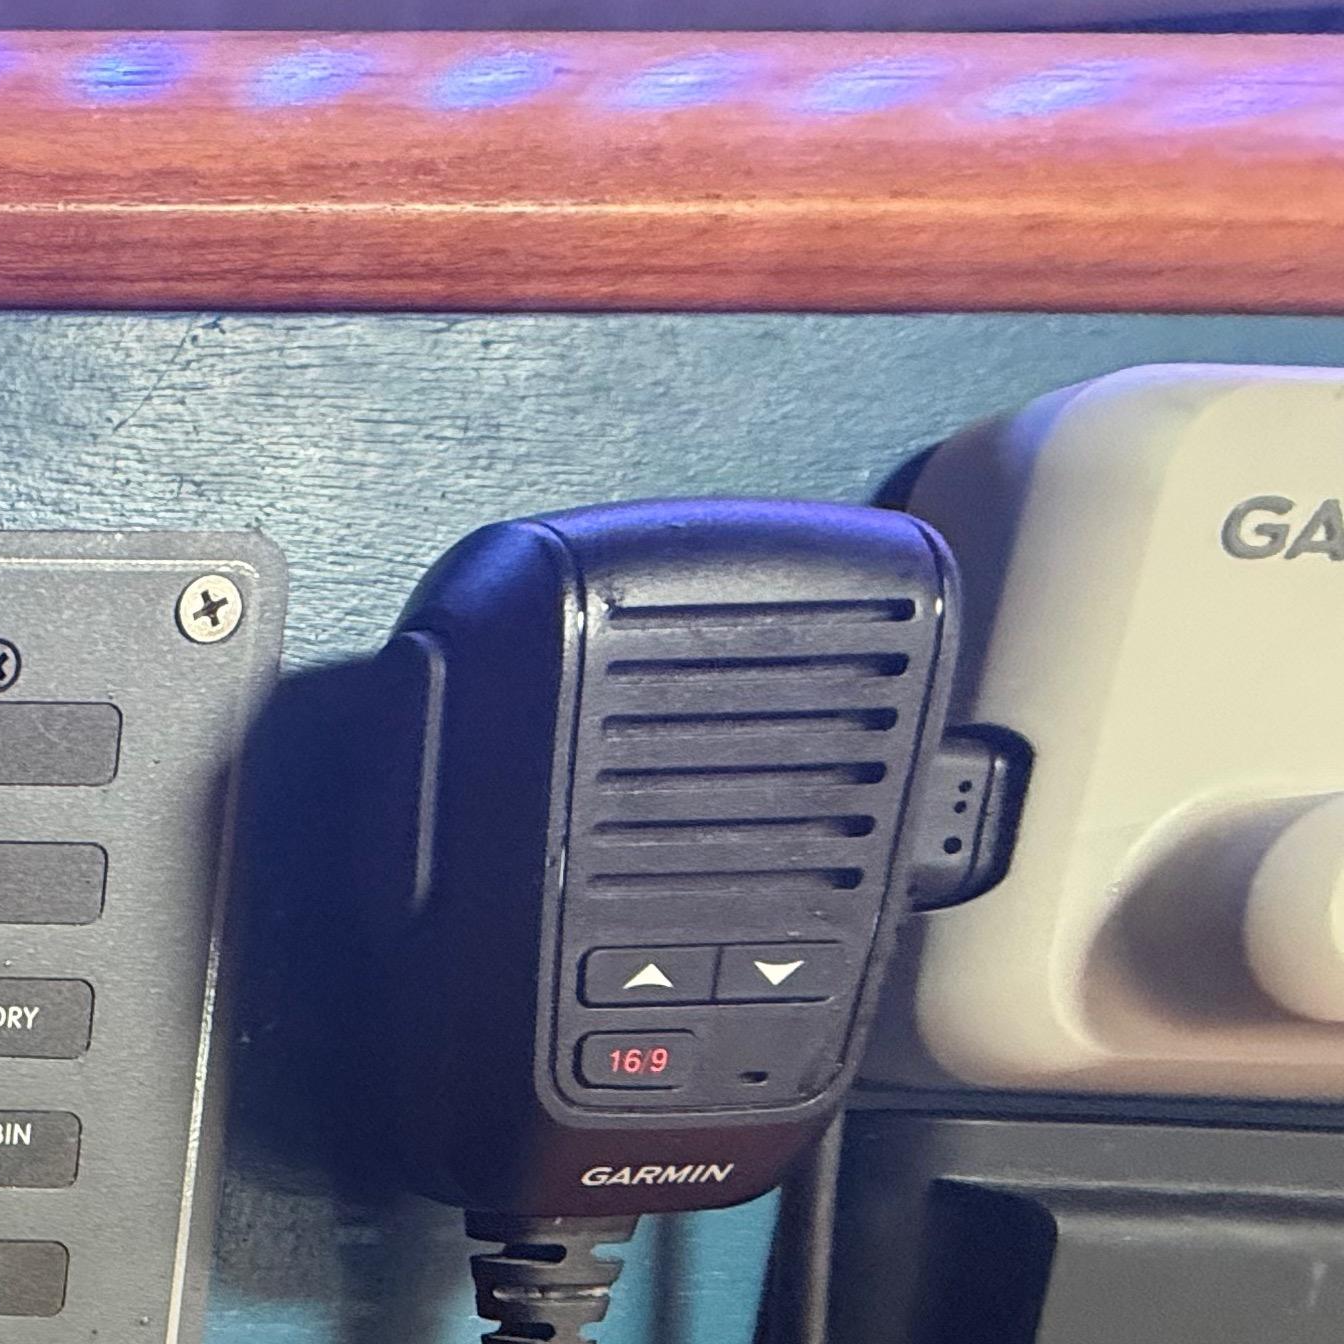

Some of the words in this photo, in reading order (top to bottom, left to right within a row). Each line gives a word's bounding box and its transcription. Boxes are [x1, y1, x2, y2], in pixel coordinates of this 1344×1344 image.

[1220, 494, 1344, 562] GA
[609, 1048, 670, 1074] 16/9
[580, 1163, 736, 1187] GARMIN
